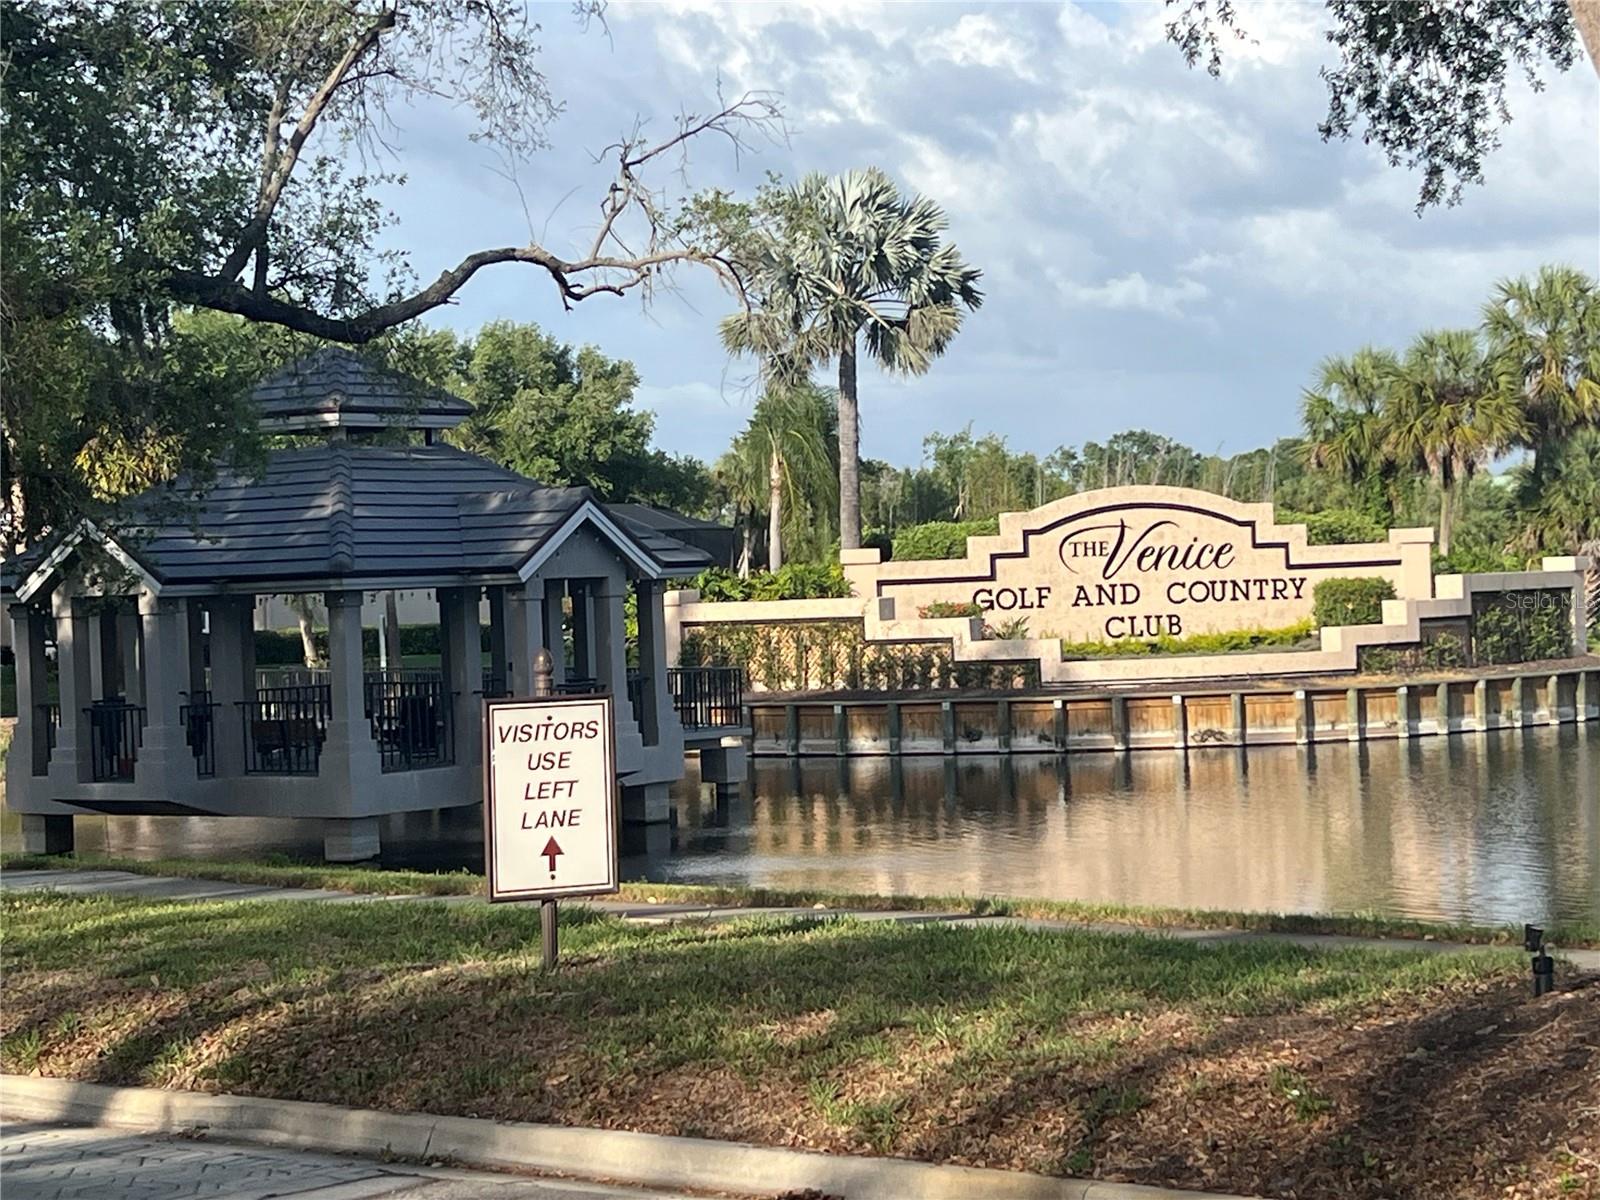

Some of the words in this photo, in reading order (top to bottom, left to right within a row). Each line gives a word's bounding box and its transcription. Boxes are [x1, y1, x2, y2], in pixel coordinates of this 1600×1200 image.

[1069, 541, 1110, 558] THE
[1102, 518, 1235, 580] Venice
[973, 588, 1051, 610] GOLF
[1071, 584, 1141, 607] AND
[1166, 578, 1307, 605] COUNTRY
[1105, 615, 1183, 639] CLUB
[498, 720, 600, 743] VISITORS
[527, 751, 573, 771] USE
[524, 780, 579, 800] LEFT
[520, 808, 583, 830] LANE
